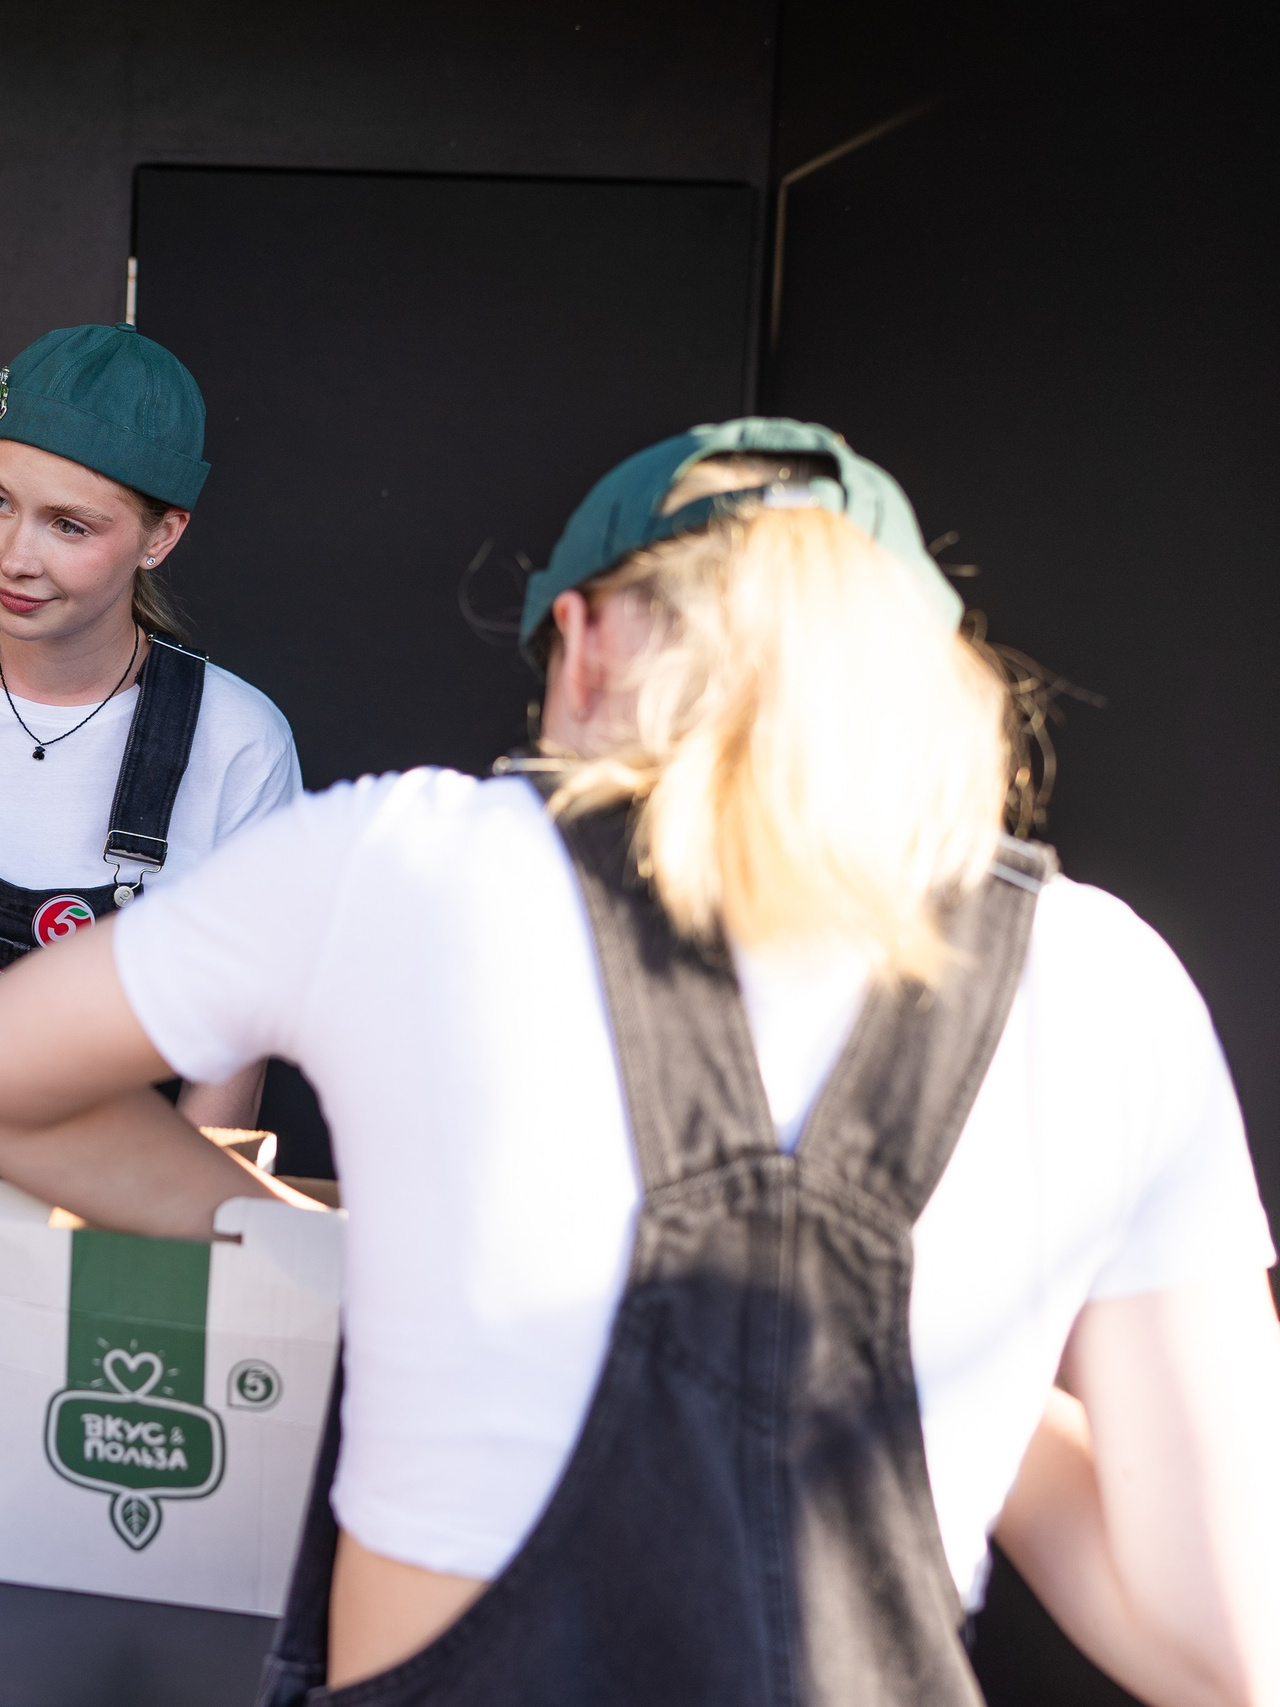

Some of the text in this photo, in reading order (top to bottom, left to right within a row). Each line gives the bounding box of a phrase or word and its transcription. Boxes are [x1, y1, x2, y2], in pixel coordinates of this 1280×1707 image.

[243, 1366, 267, 1401] 5
[81, 1413, 166, 1447] ВКУС
[84, 1437, 188, 1471] ПОЛЬЗА
